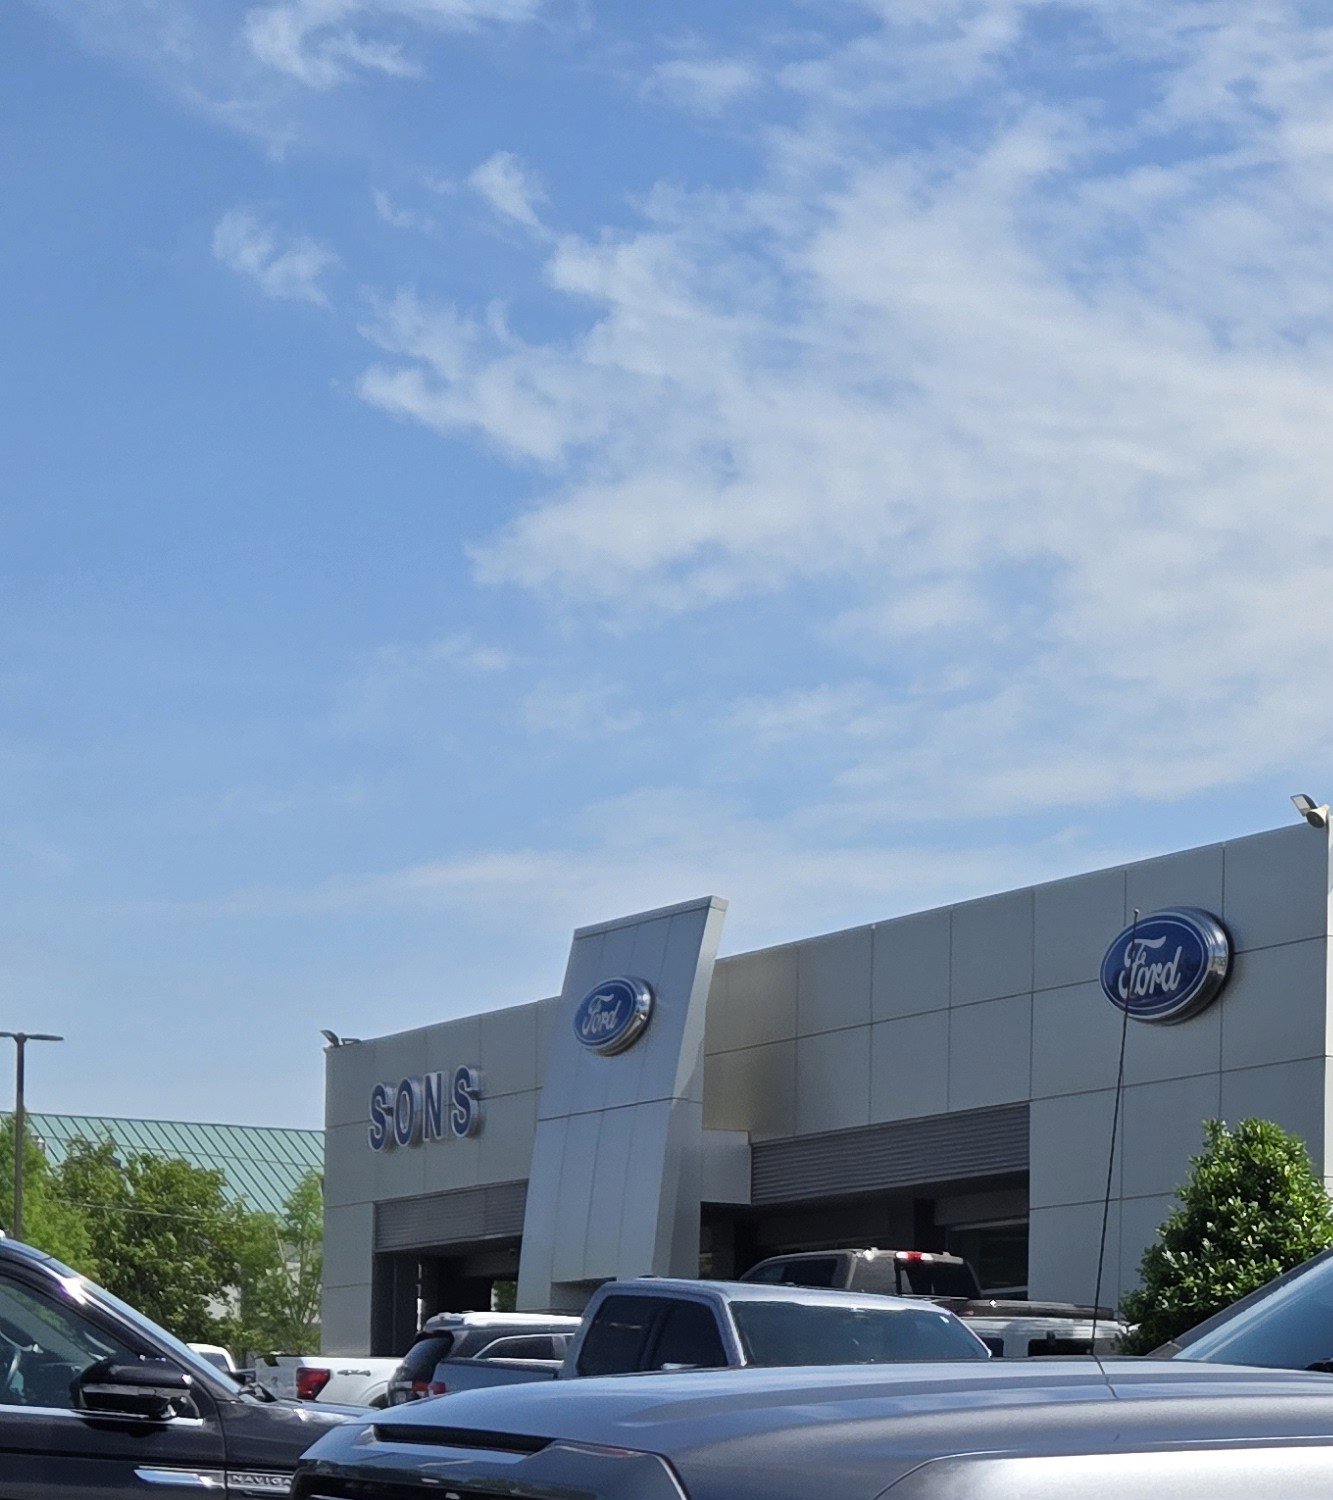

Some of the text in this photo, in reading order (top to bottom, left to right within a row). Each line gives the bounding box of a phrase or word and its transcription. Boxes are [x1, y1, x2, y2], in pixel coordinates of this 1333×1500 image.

[1118, 935, 1183, 999] Ford
[581, 993, 623, 1036] Ford
[368, 1064, 481, 1152] SONS
